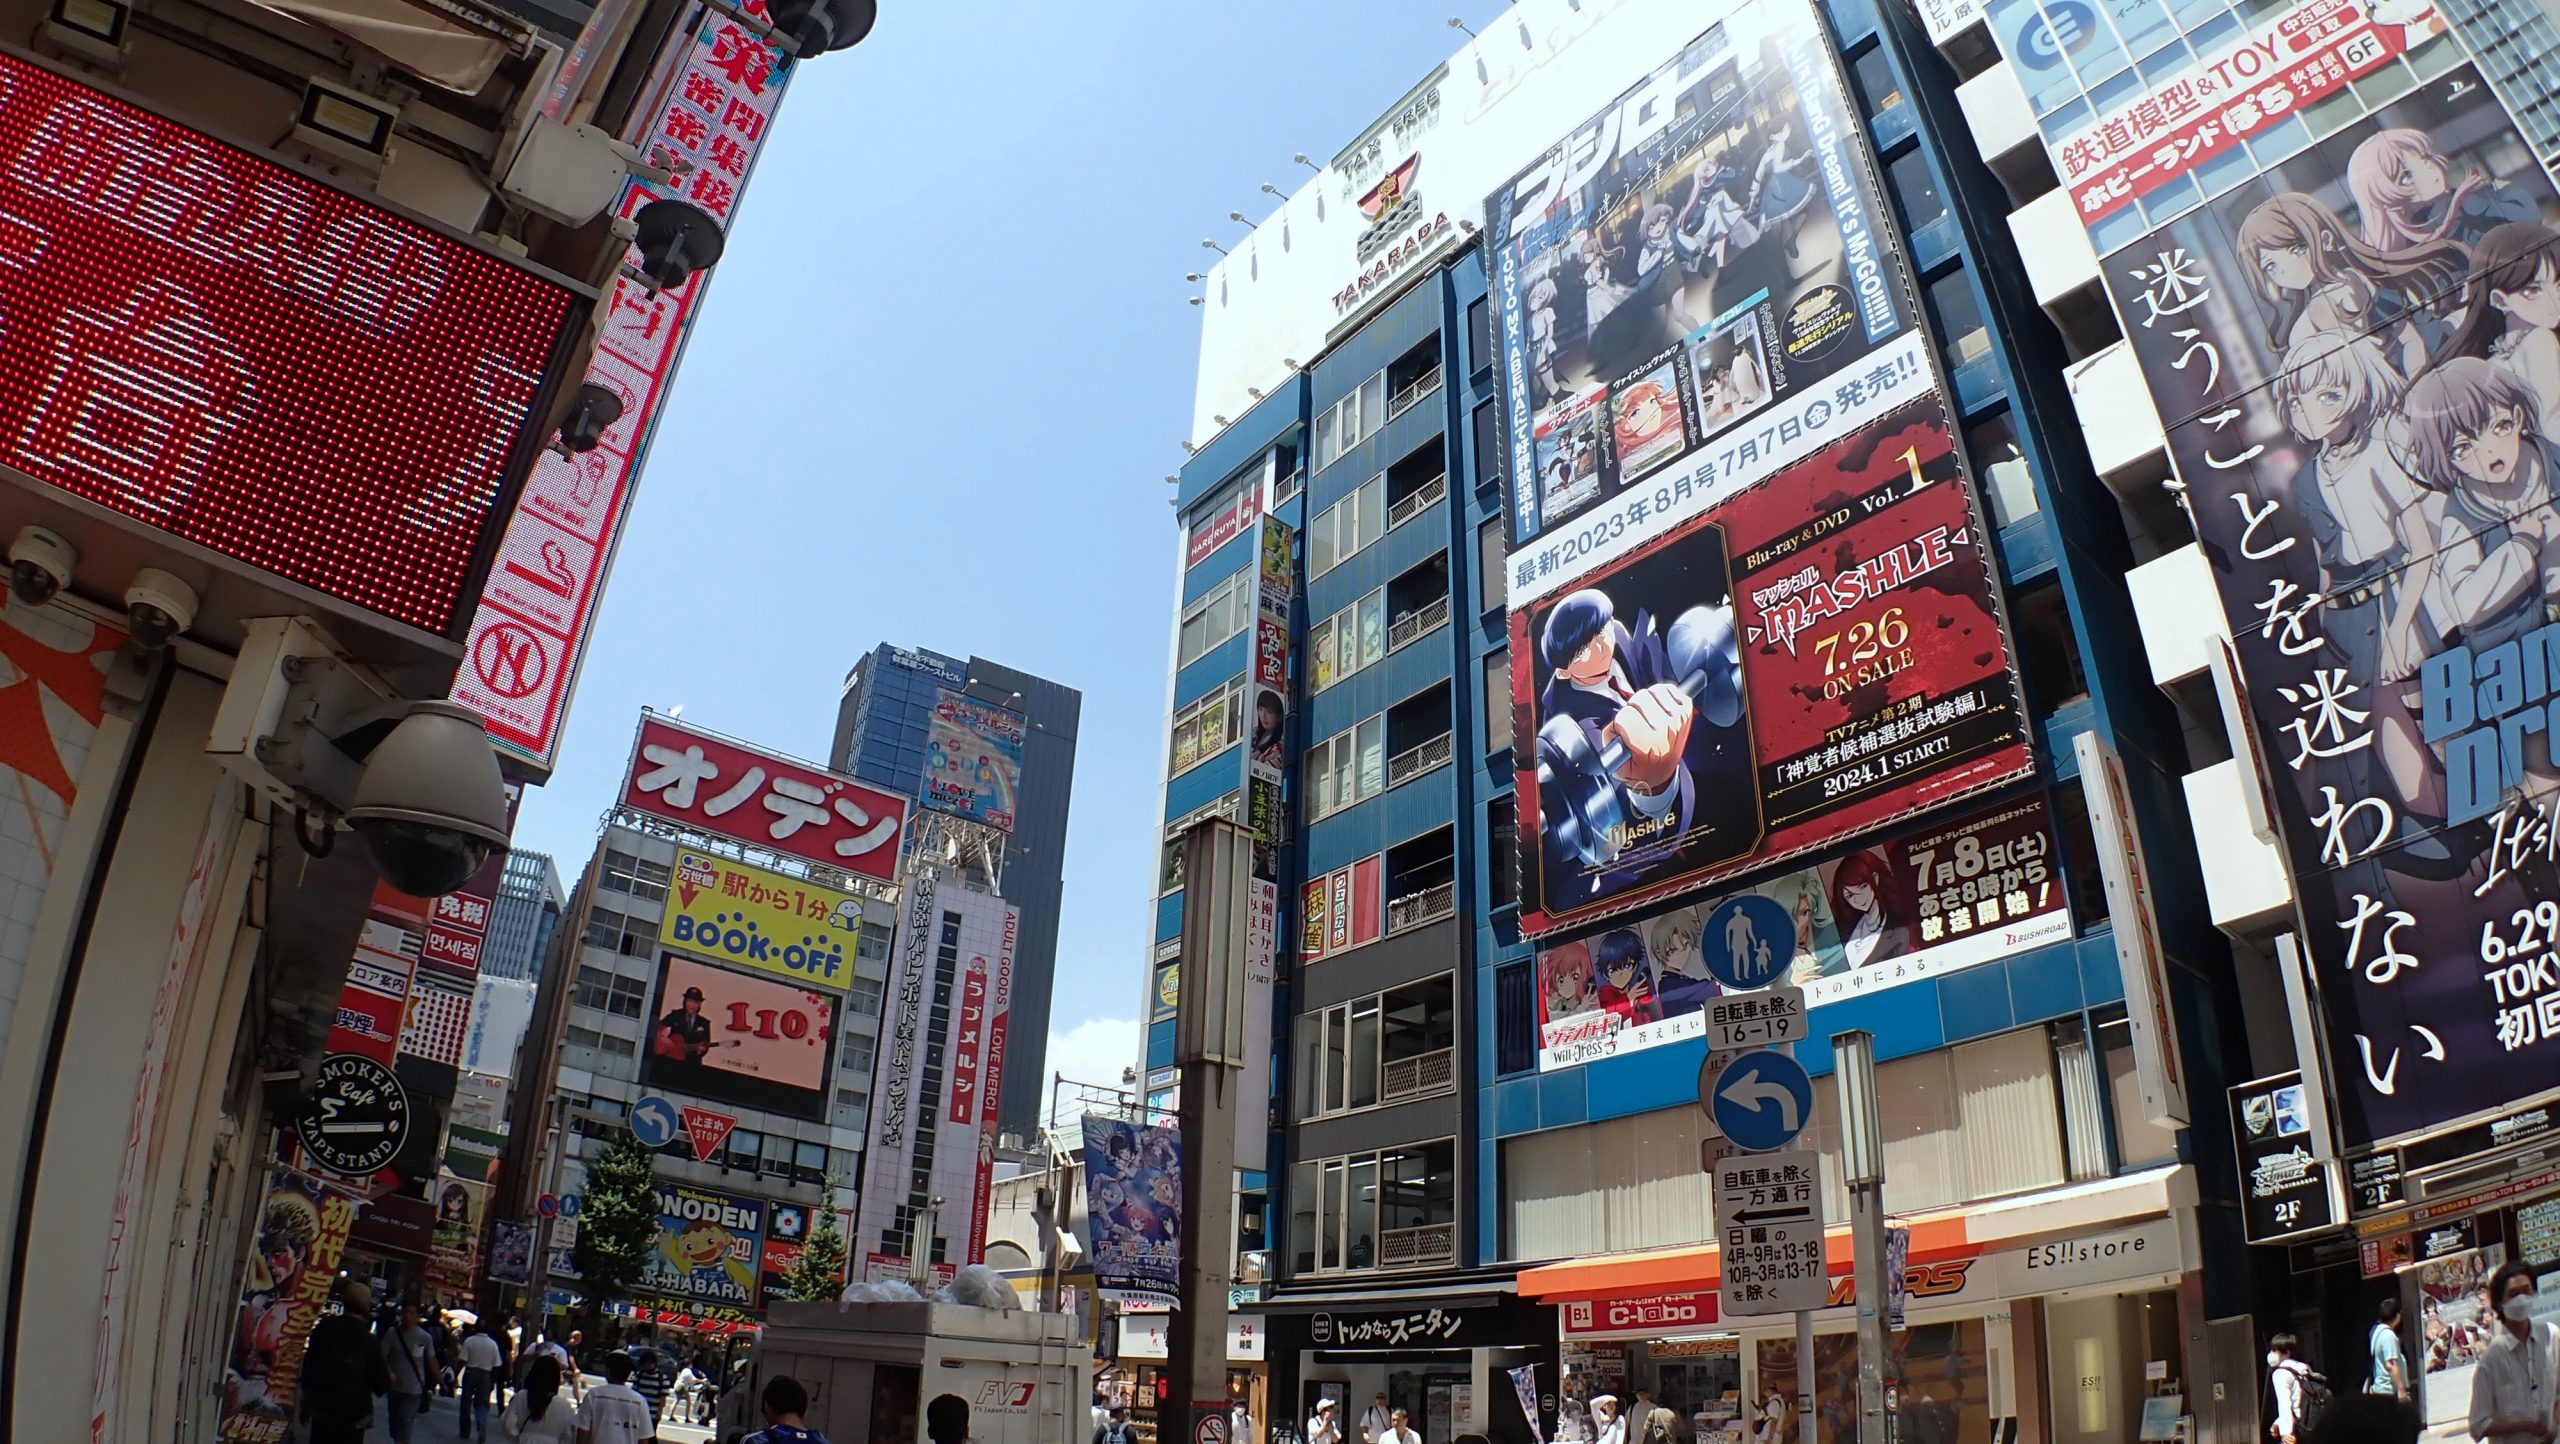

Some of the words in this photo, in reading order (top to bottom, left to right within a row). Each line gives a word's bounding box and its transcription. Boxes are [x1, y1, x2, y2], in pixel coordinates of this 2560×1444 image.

[2305, 17, 2343, 44] 買取
[2345, 35, 2376, 65] 6F
[2289, 51, 2339, 86] 秋葉原
[2298, 65, 2345, 98] 2号店
[1341, 137, 1381, 176] TAX
[1392, 87, 1441, 136] FREE
[2079, 81, 2296, 214] ホビーランドぽち
[1816, 130, 1848, 200] Dream!
[1836, 194, 1861, 234] It's
[1331, 210, 1448, 310] TAKARADA
[1500, 248, 1520, 307] TOKYO
[1787, 311, 1854, 354] 最速先行シリアル
[1612, 342, 1680, 390] ヴァイスシュヴァルツ
[1548, 397, 1593, 430] ヴァンガード
[1746, 531, 1800, 571] Blu-ray
[1801, 528, 1813, 542] &
[1812, 508, 1852, 531] DVD
[1859, 488, 1900, 515] Vol.
[1894, 444, 1936, 499] 1
[1752, 564, 1821, 608] マッシュル
[1758, 525, 1954, 658] MASHLE
[1260, 595, 1289, 620] 麻雀
[1261, 623, 1282, 682] ウェルカム
[1813, 607, 1910, 678] 7.26
[1822, 674, 1853, 701] ON
[1856, 648, 1915, 688] SALE
[2129, 247, 2446, 1096] 迷うことを迷わない
[1775, 690, 1988, 784] 「神覚者候補選抜試験編」
[1825, 694, 1924, 744] TVアニメ第2期
[1823, 756, 1890, 798] 2024.1
[1893, 735, 1951, 771] START!
[637, 743, 899, 858] オノデン
[677, 866, 717, 889] 万世橋
[1909, 831, 2048, 893] 7月8日(土)
[721, 870, 829, 923] 駅から1分
[1334, 874, 1347, 942] ウェルカム
[1918, 859, 2048, 918] あさ8時から
[439, 895, 485, 926] 免税
[1303, 886, 1326, 951] 麻雀
[1920, 881, 2050, 942] 放送開始!
[2479, 899, 2559, 964] 6.29
[428, 934, 479, 961] 면세점
[1001, 911, 1017, 953] ADULT
[2017, 921, 2067, 943] BUSHIROAD
[996, 956, 1012, 1007] GOODS
[1813, 959, 1946, 1001] トの中にある。
[1638, 1019, 1700, 1044] 答えはい
[1713, 998, 1797, 1024] 自転車を除く
[956, 980, 986, 1118] ラブメルシー
[990, 1026, 1005, 1064] LOVE
[339, 1081, 378, 1106] Cafe
[984, 1065, 1001, 1111] MERCI
[303, 1114, 333, 1161] VAPE
[335, 1138, 392, 1168] STAND
[691, 1114, 725, 1133] 止まれ
[694, 1128, 719, 1143] STOP
[677, 1188, 719, 1204] Welcome
[718, 1194, 730, 1206] to
[1723, 1164, 1812, 1189] 自転車を除く
[1726, 1183, 1812, 1206] 一方通行
[2364, 1183, 2392, 1206] 2F
[2274, 1199, 2302, 1223] 2F
[1729, 1226, 1787, 1246] 日曜の
[1243, 1289, 1256, 1298] Free
[1573, 1307, 1590, 1321] B1
[1732, 1284, 1779, 1302] を除く
[1240, 1324, 1254, 1337] 24
[1608, 1303, 1697, 1326] C-labo
[1239, 1339, 1253, 1351] 時間
[1647, 1340, 1741, 1358] GAMERS
[2081, 1375, 2101, 1387] ES!!
